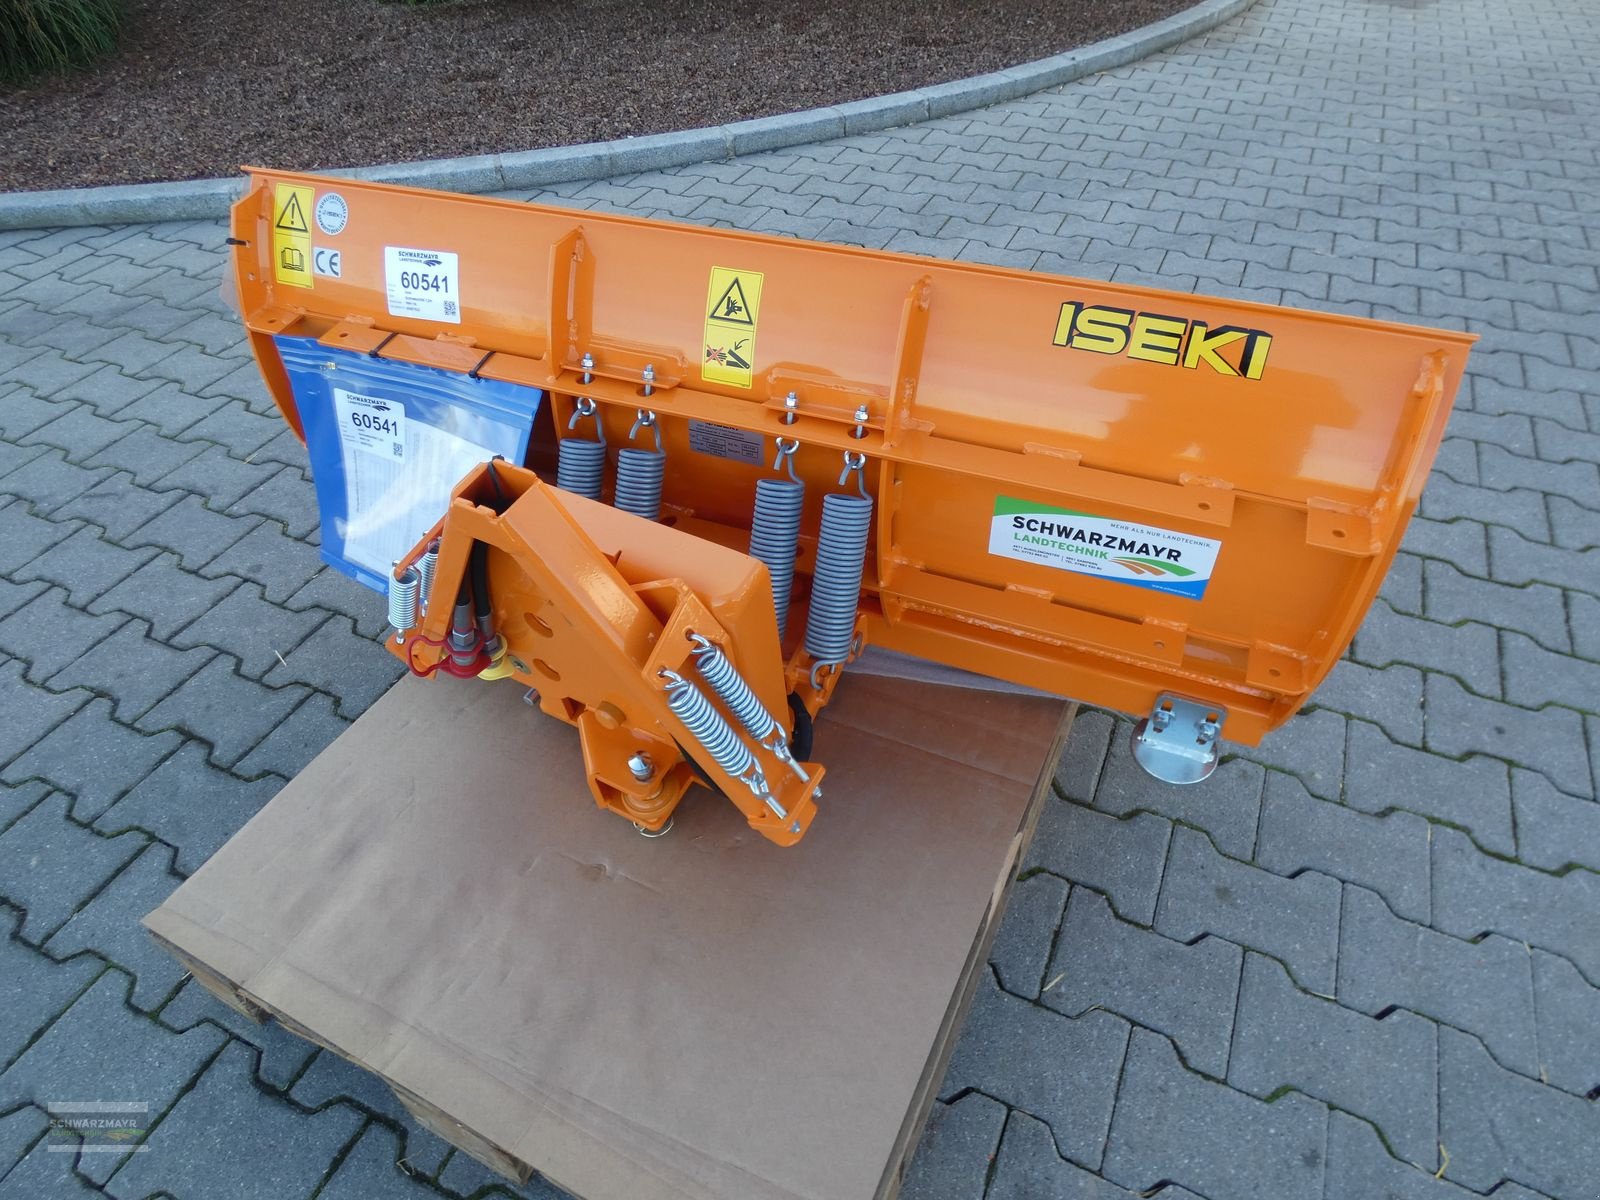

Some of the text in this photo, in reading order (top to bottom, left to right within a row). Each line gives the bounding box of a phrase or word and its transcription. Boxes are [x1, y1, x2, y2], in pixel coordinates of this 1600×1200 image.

[315, 250, 339, 276] CE
[398, 251, 439, 259] SCHWARZMAYR
[401, 271, 449, 293] 60541
[1052, 300, 1273, 381] ISEKI
[346, 394, 387, 406] SCHWARZMAYR
[352, 412, 398, 437] 60541
[1012, 515, 1182, 562] SCHWARZMAYR
[1013, 532, 1109, 560] LANDTECHNIK
